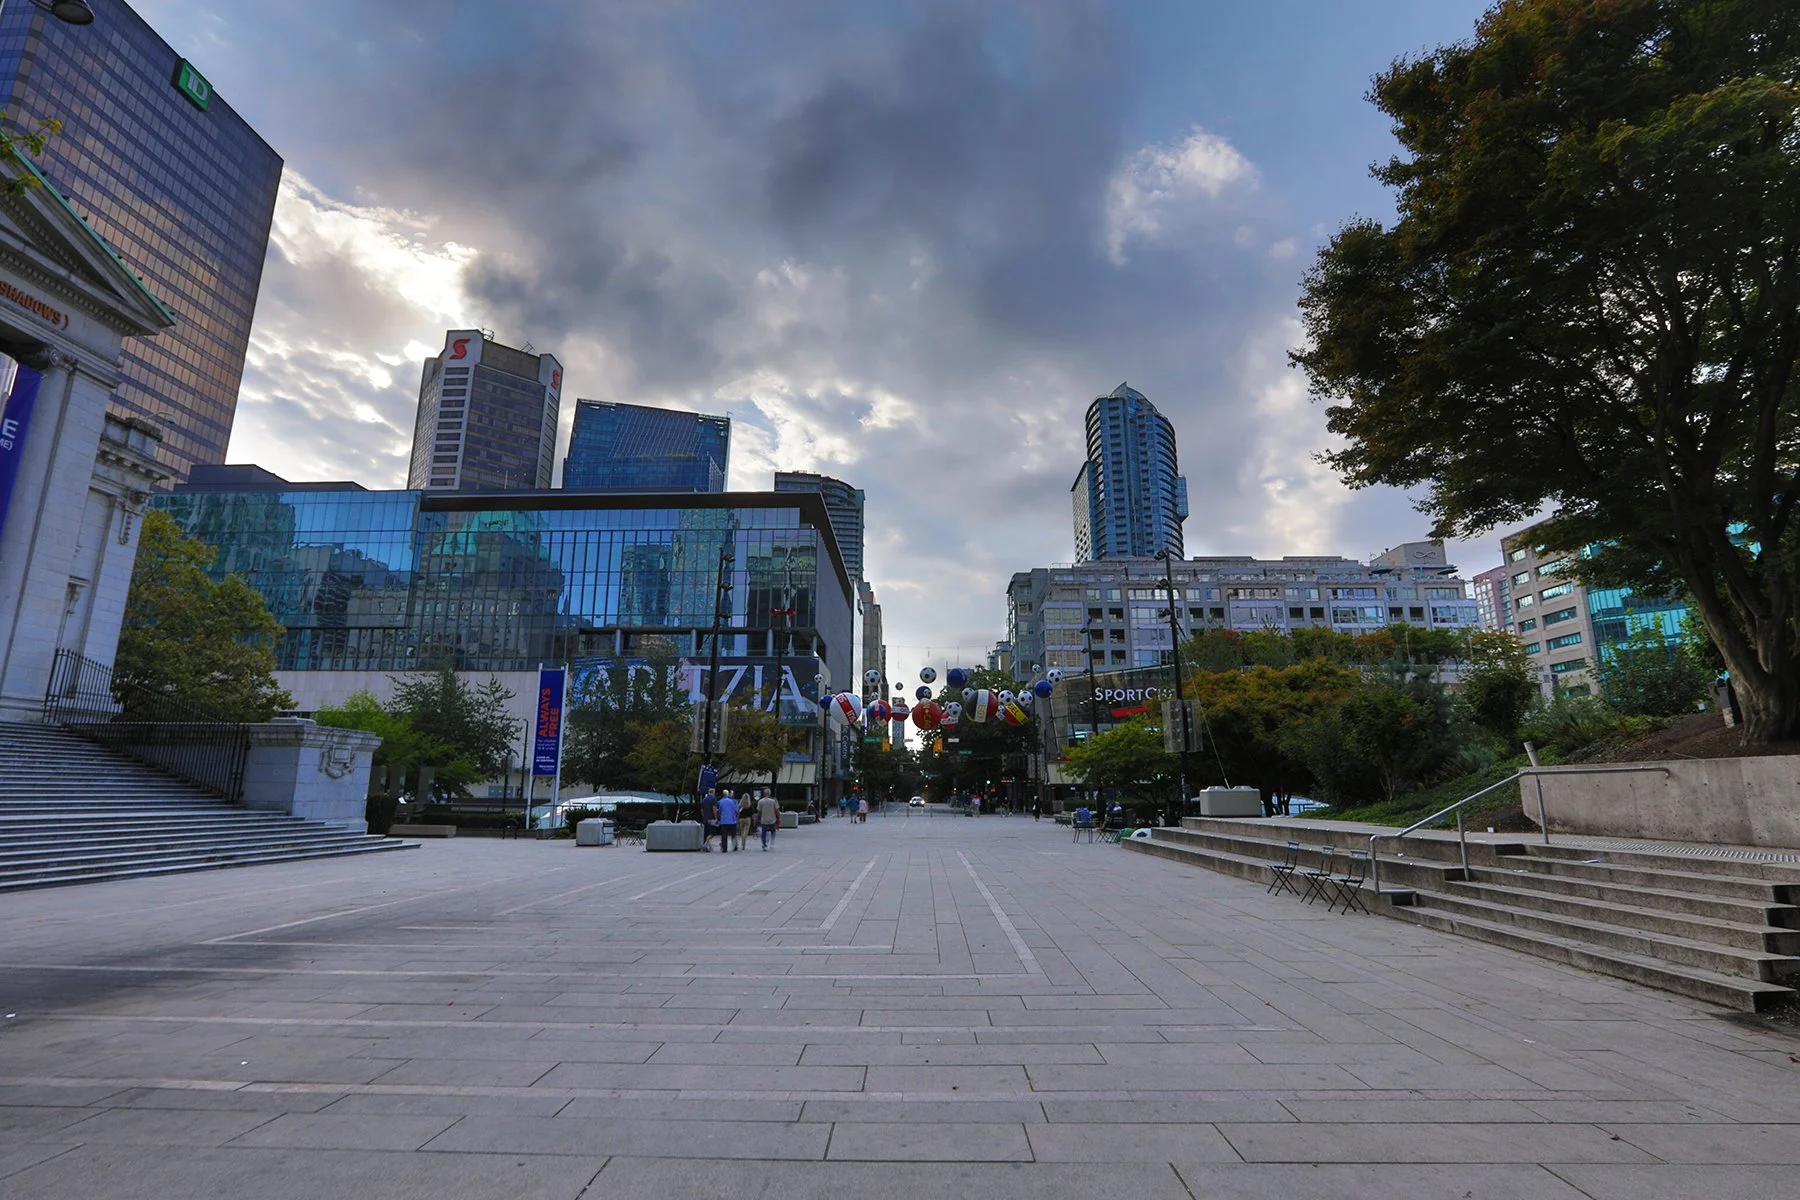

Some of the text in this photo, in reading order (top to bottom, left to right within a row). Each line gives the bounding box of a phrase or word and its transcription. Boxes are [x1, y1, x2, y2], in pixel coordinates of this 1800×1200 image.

[185, 66, 208, 101] TD
[538, 687, 551, 737] ALWAYS
[549, 707, 560, 737] FREE
